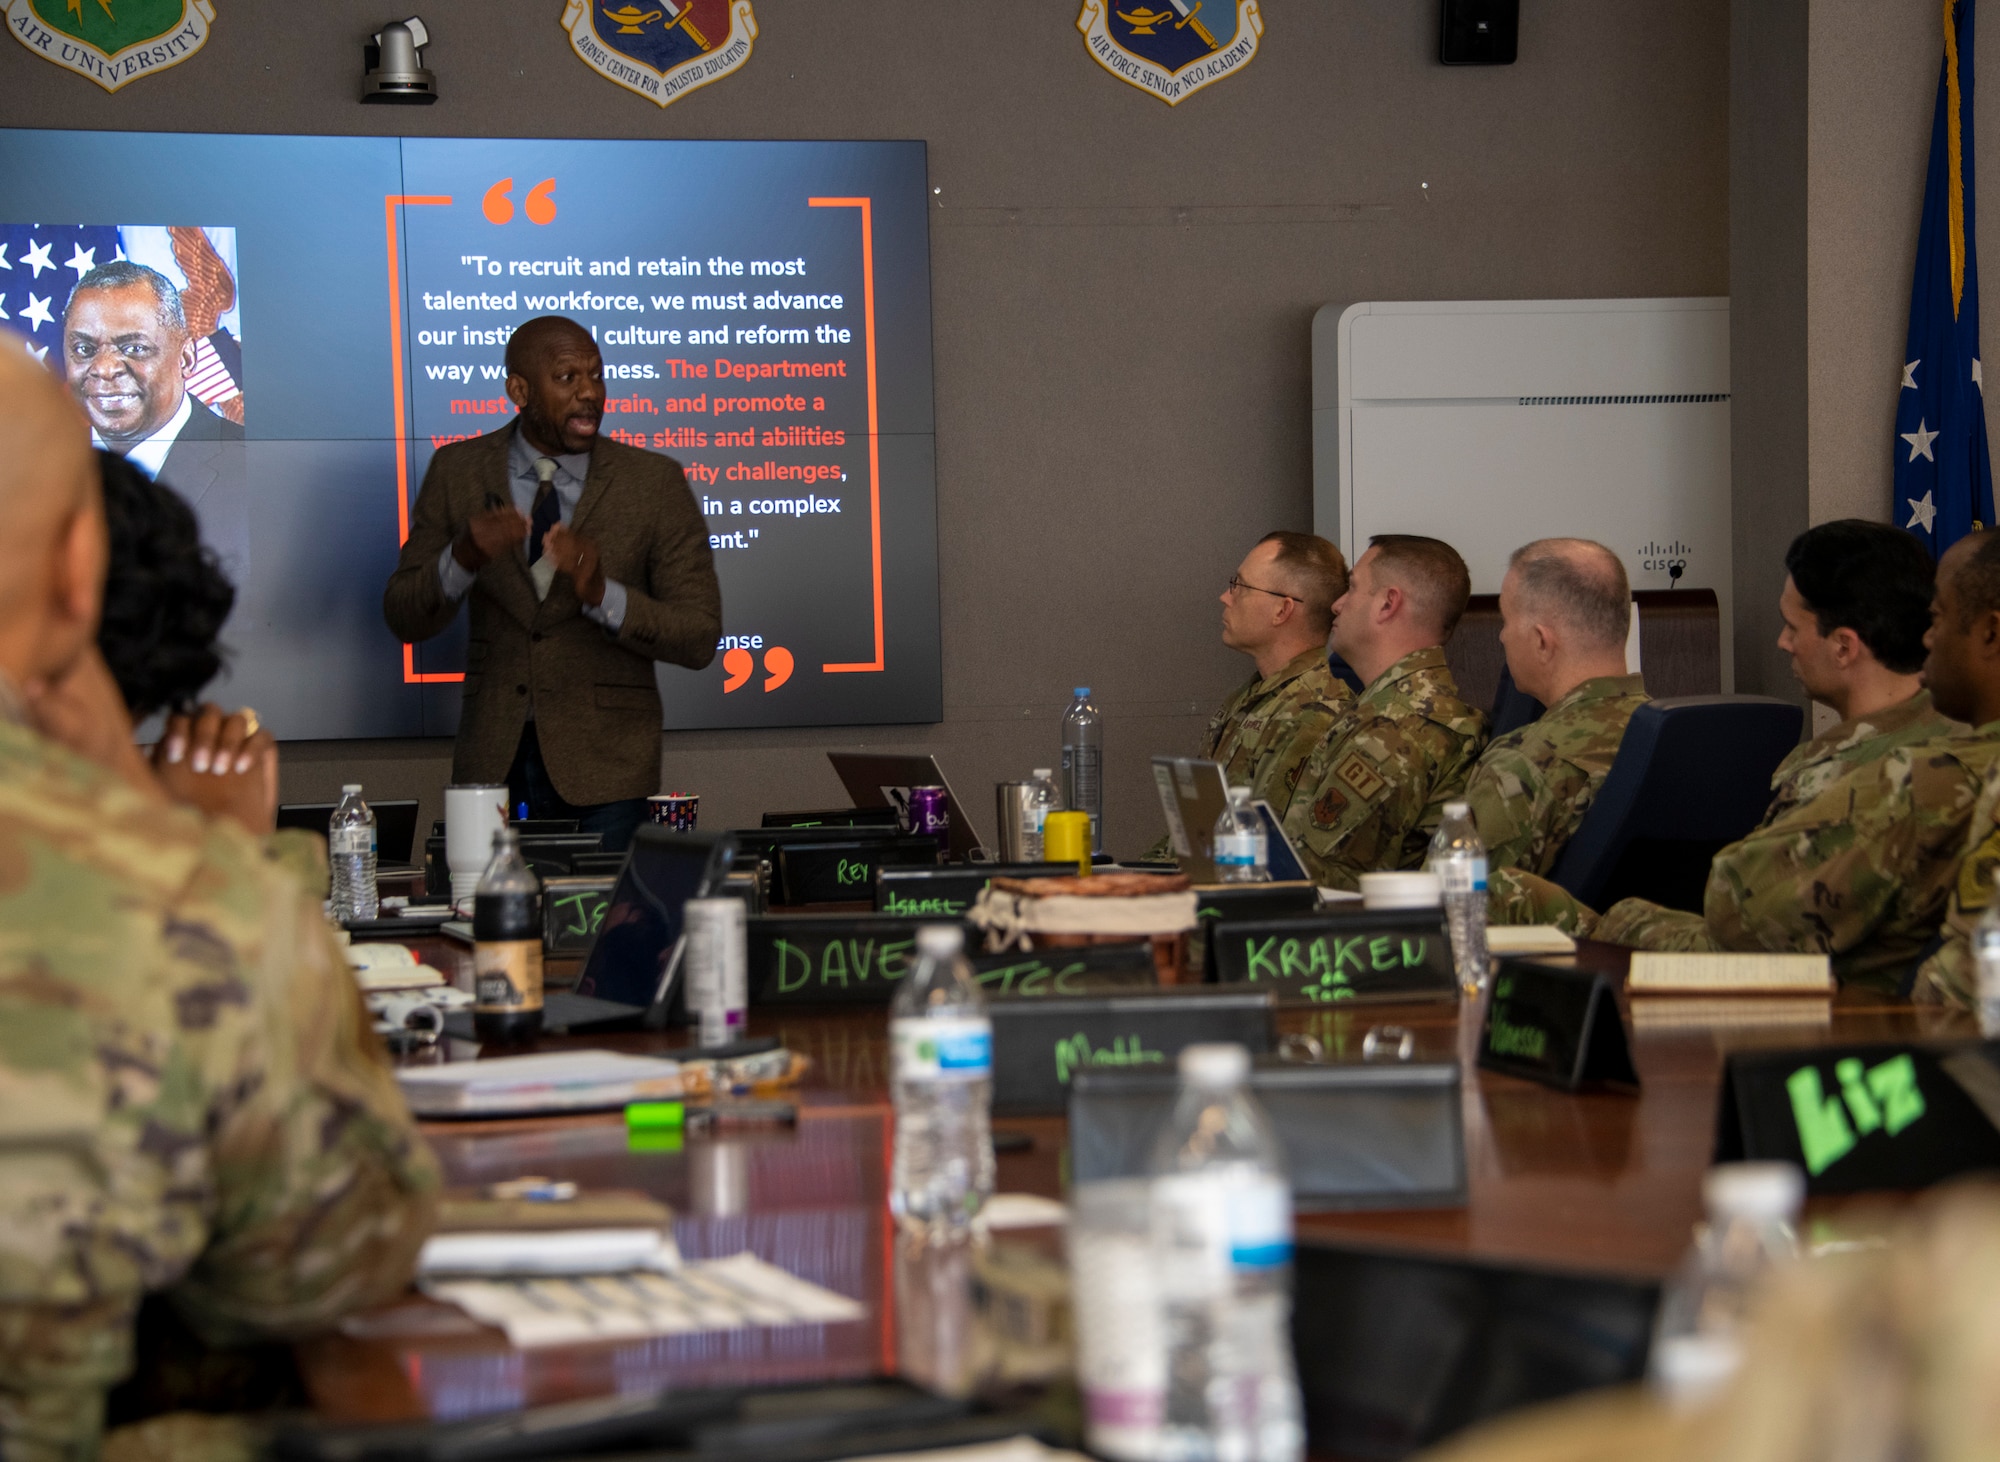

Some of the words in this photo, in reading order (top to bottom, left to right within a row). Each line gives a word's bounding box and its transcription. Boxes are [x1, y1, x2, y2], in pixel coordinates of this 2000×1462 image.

[13, 15, 53, 51] AIR
[61, 20, 200, 83] UNIVERSITY
[576, 35, 608, 67] BARNES
[606, 58, 641, 88] CENTER
[641, 74, 660, 96] FOR
[664, 66, 704, 97] ENLISTED
[705, 38, 749, 76] EDUCATION
[1090, 34, 1110, 57] AIR
[1108, 49, 1140, 79] FORCE
[1141, 70, 1180, 97] SENIOR
[1181, 67, 1205, 90] NCO
[1207, 36, 1253, 78] ACADEMY
[460, 255, 503, 276] "To
[508, 255, 584, 276] recruit
[588, 255, 631, 276] and
[637, 255, 702, 276] retain
[707, 256, 744, 276] the
[750, 257, 806, 276] most
[422, 290, 518, 311] talented
[523, 290, 645, 313] workforce,
[650, 295, 685, 311] we
[691, 292, 748, 310] must
[752, 290, 844, 310] advance
[417, 330, 458, 346] our
[604, 325, 682, 345] culture
[687, 324, 729, 345] and
[735, 324, 809, 345] reform
[814, 324, 851, 344] the
[424, 364, 474, 385] way
[603, 364, 660, 379] ness.
[665, 359, 709, 379] The
[715, 358, 847, 383] Department
[451, 396, 508, 414] must
[603, 393, 659, 415] train,
[665, 393, 707, 413] and
[713, 393, 807, 417] promote
[812, 396, 825, 411] a
[653, 427, 708, 449] skills
[714, 426, 755, 447] and
[761, 425, 846, 447] abilities
[683, 461, 720, 486] rity
[725, 461, 847, 484] challenges,
[703, 495, 723, 515] in
[729, 500, 743, 515] a
[748, 494, 841, 518] complex
[1345, 762, 1376, 790] GT
[773, 937, 916, 994] DAVE
[1246, 934, 1427, 982] KRAKEN
